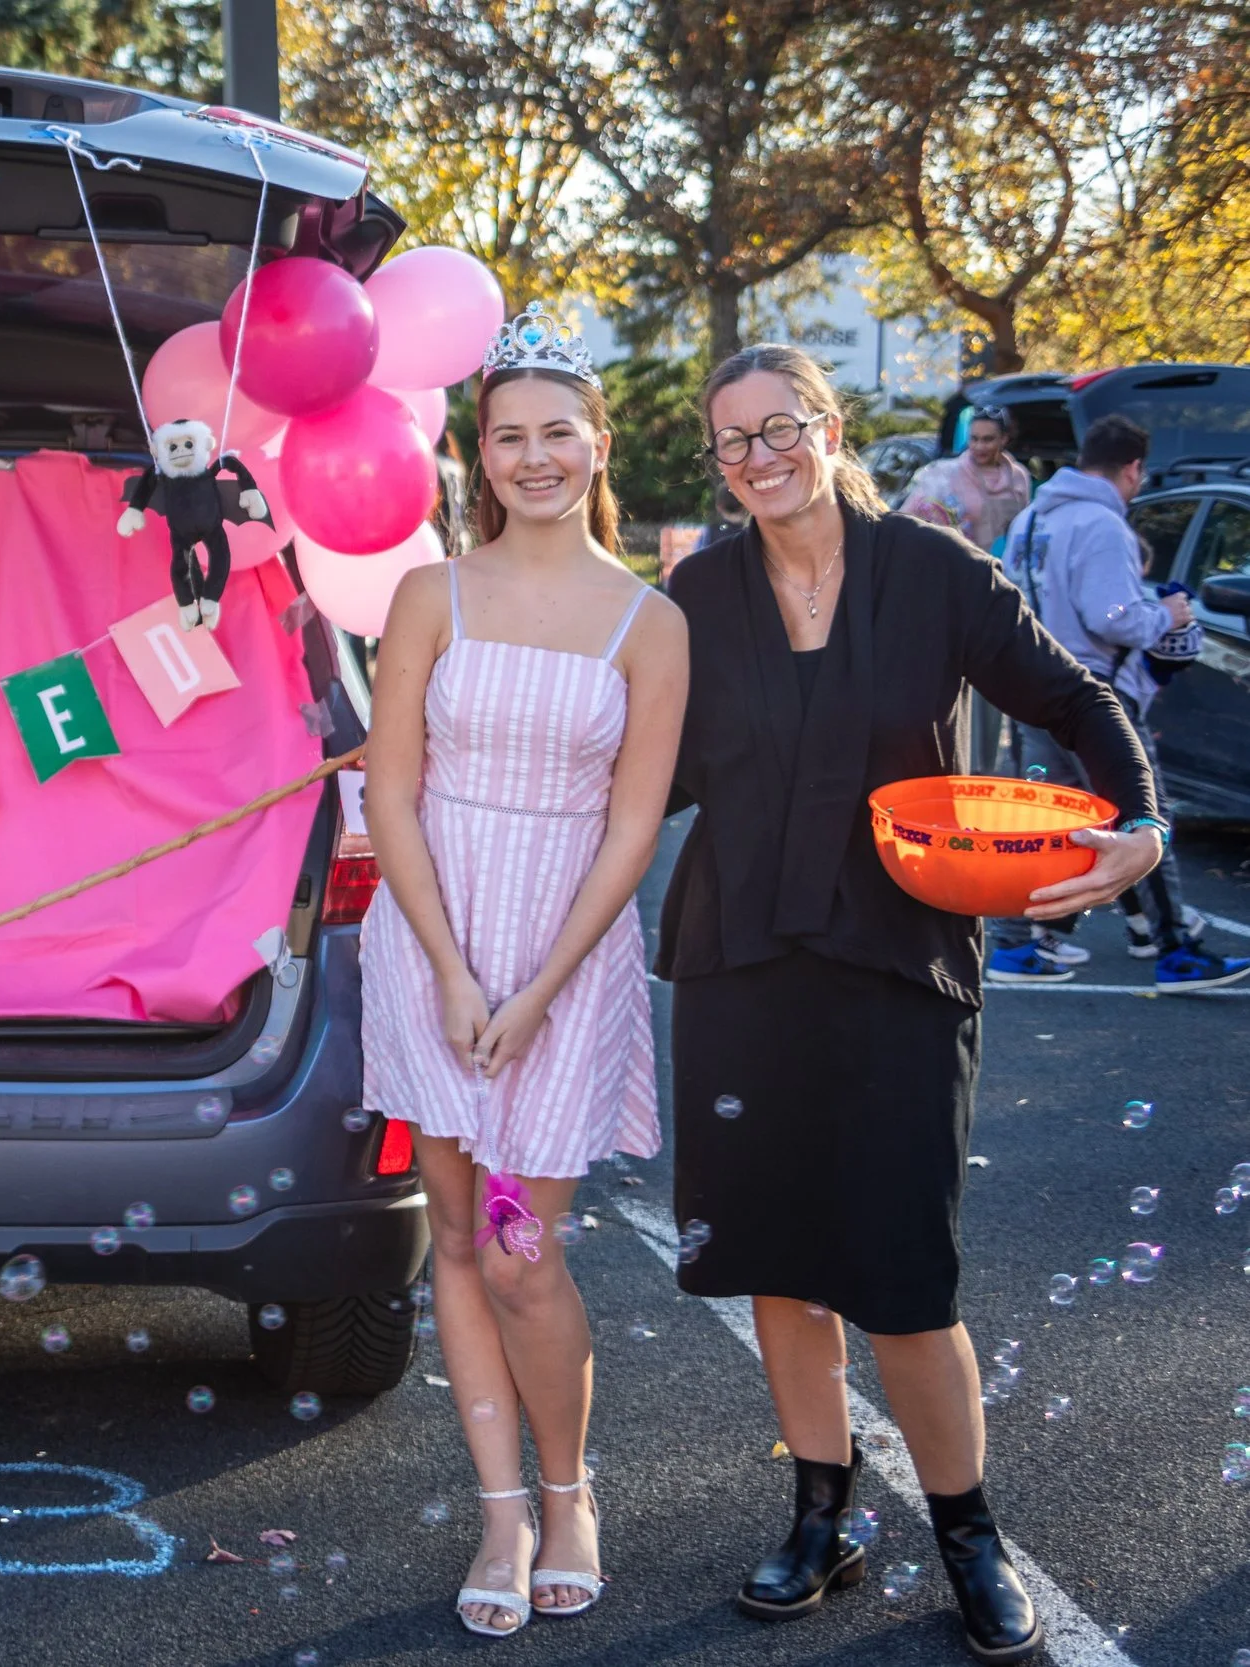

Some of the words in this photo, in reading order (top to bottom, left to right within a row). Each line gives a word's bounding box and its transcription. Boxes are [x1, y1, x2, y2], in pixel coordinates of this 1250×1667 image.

[891, 822, 933, 847] TRICK
[947, 837, 975, 852] OR
[992, 838, 1046, 854] TREAT
